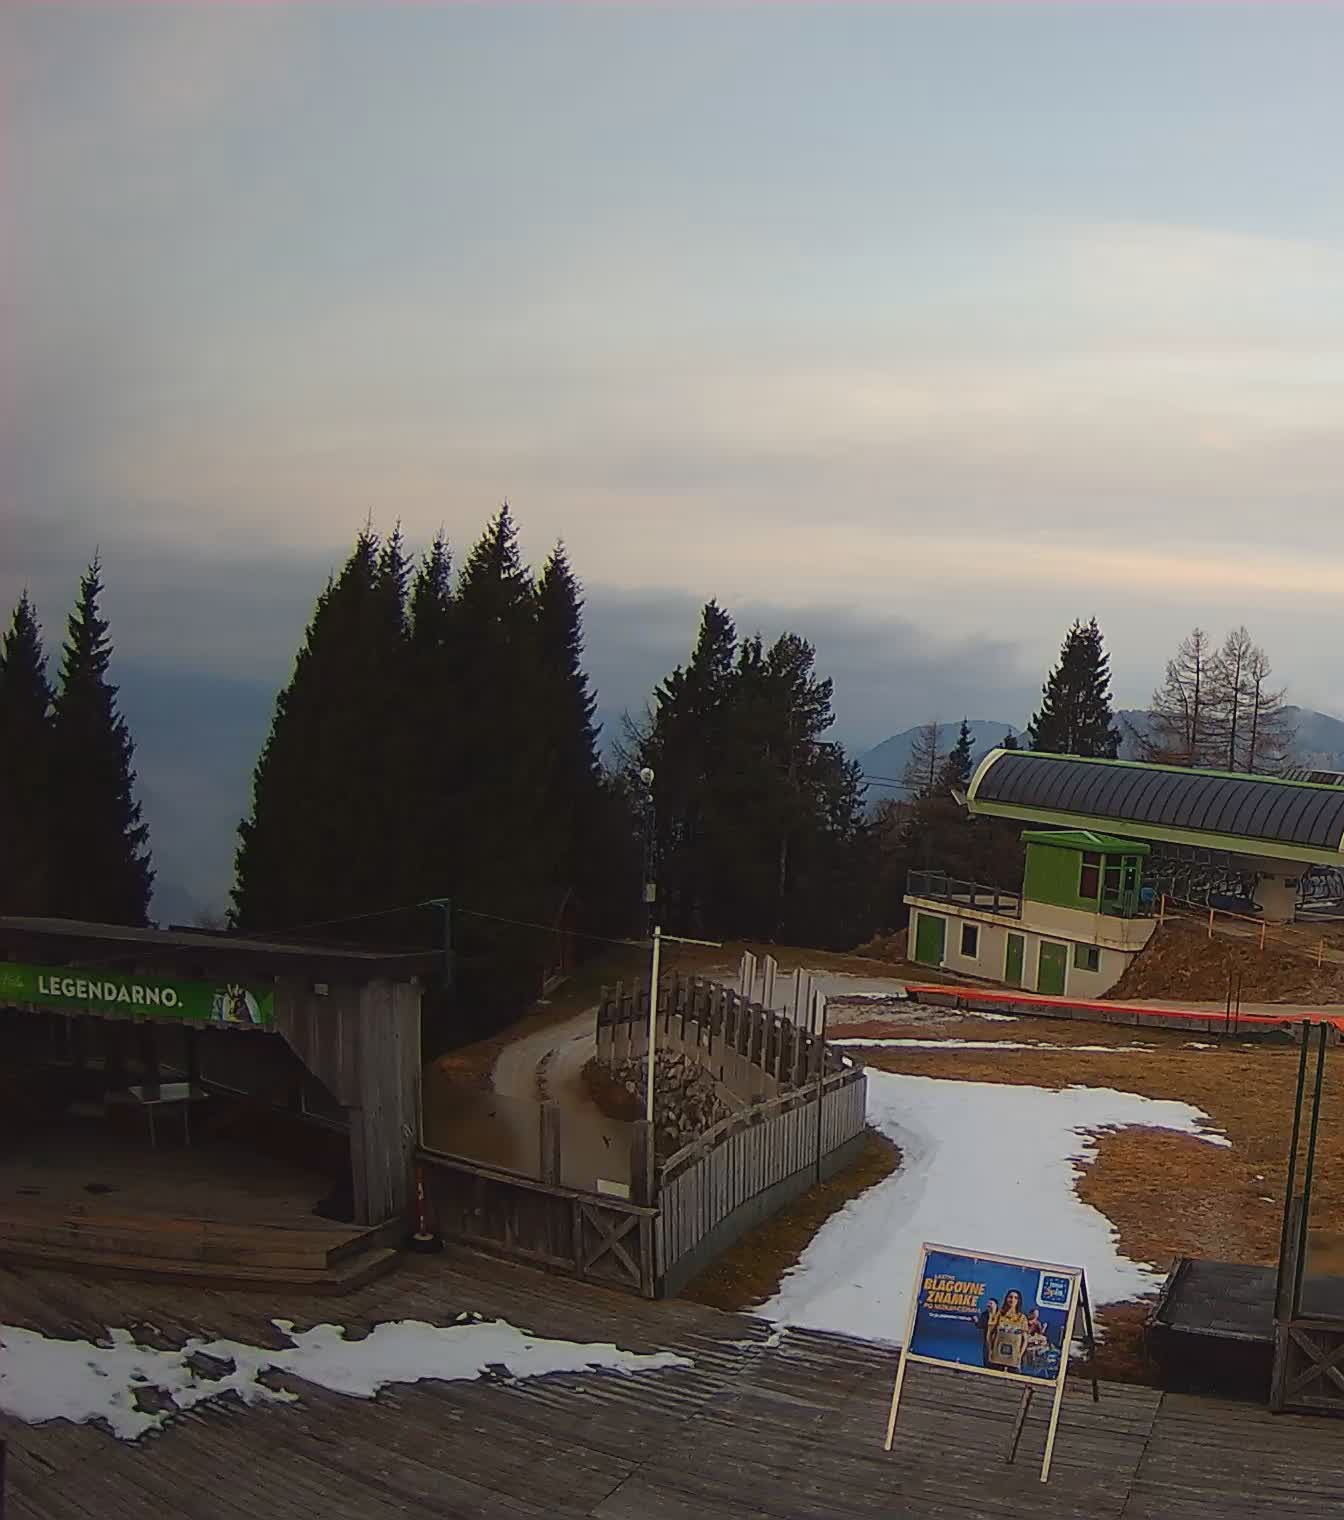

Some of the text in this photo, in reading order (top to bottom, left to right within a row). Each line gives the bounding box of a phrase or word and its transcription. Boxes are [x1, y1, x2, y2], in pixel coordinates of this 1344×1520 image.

[37, 975, 183, 1007] LEGENDARNO.
[923, 1278, 987, 1296] BLAGOVNE
[926, 1290, 979, 1307] ZNAMKE
